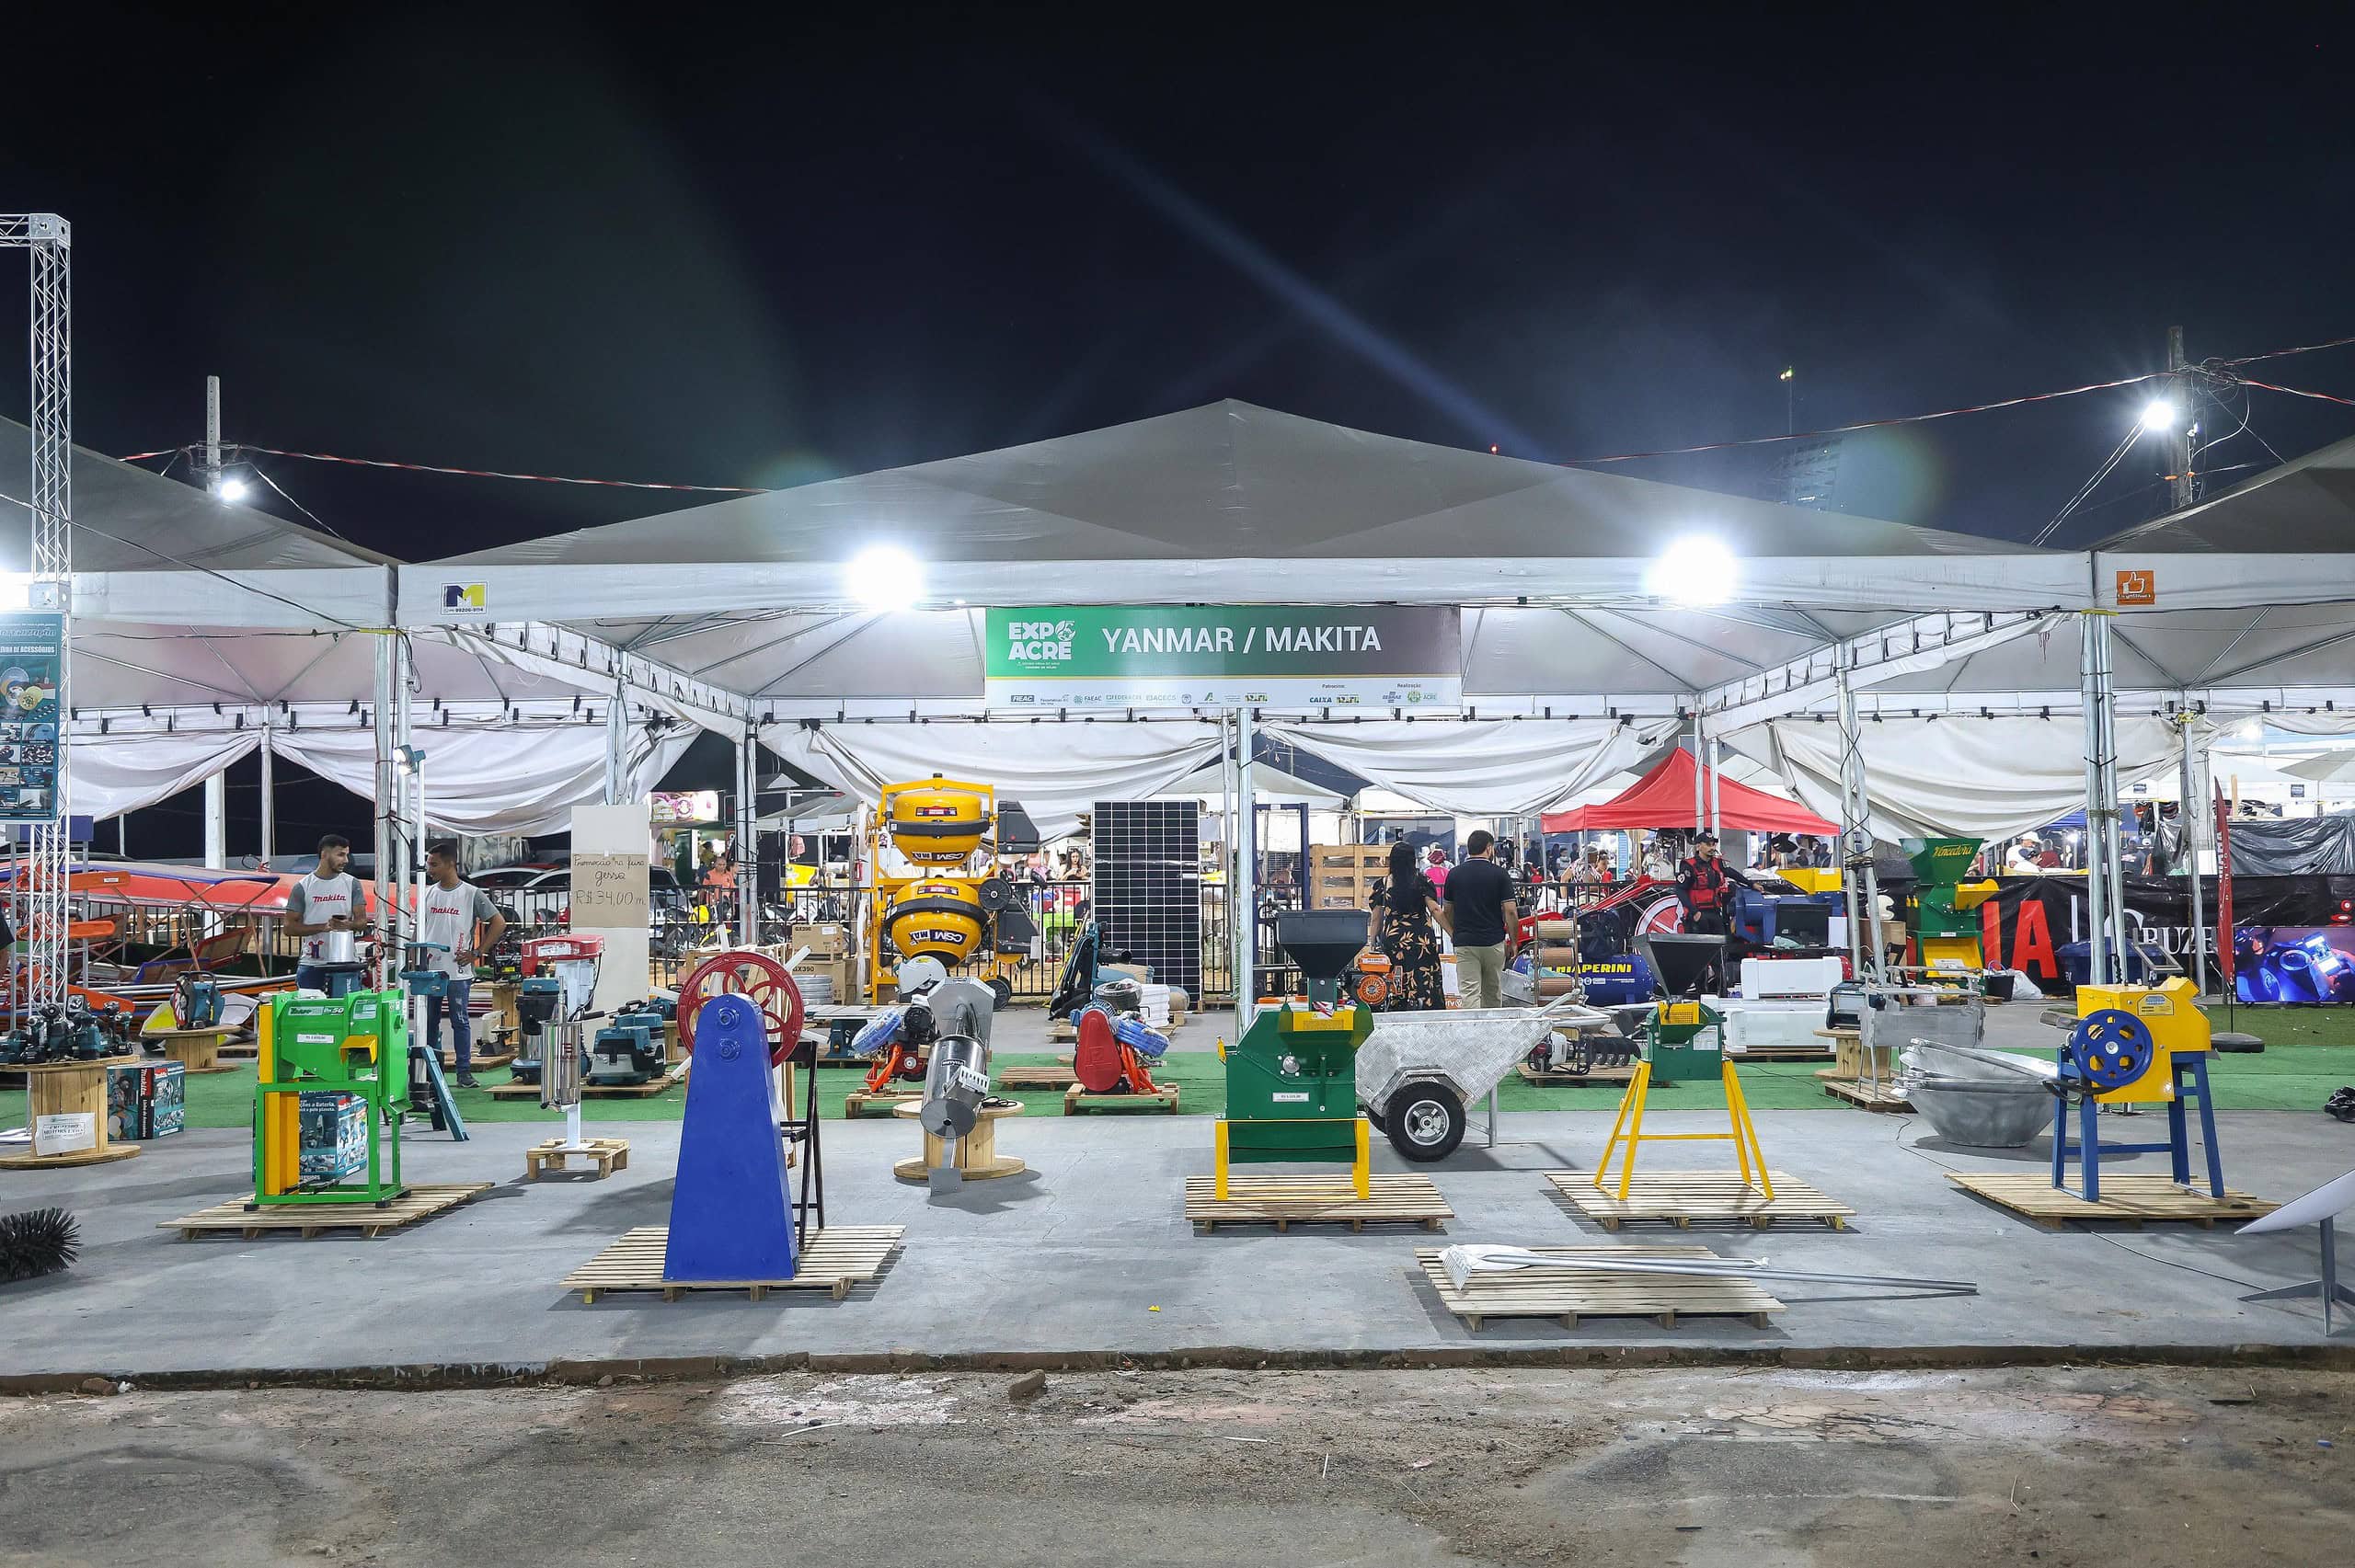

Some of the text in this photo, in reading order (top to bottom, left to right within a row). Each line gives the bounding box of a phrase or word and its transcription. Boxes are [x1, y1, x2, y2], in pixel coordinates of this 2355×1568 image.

[1102, 627, 1235, 654] YANMAR
[1265, 625, 1383, 653] MAKITA
[1008, 641, 1072, 660] ACRE
[936, 853, 964, 861] CSM
[934, 931, 963, 943] CSM
